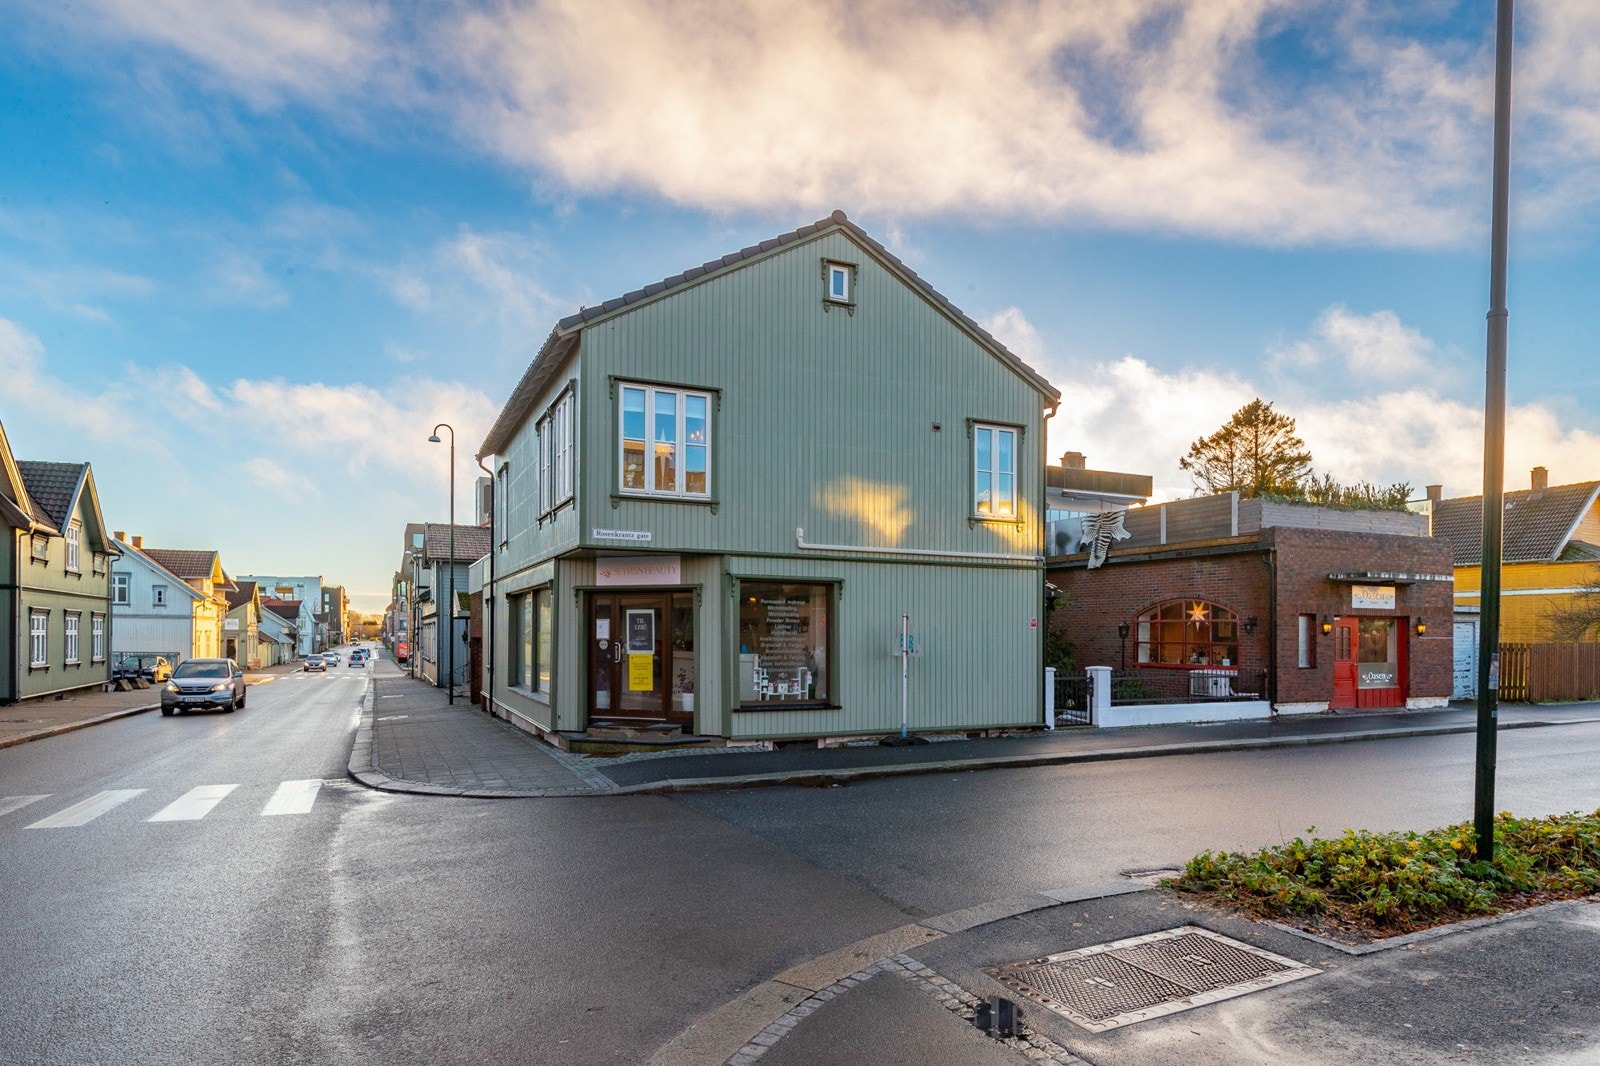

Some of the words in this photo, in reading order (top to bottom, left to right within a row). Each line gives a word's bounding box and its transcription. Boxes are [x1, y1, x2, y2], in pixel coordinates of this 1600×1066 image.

[596, 530, 634, 538] Rosenkrantz
[1362, 589, 1385, 600] Oasen
[1369, 671, 1386, 680] Oasen
